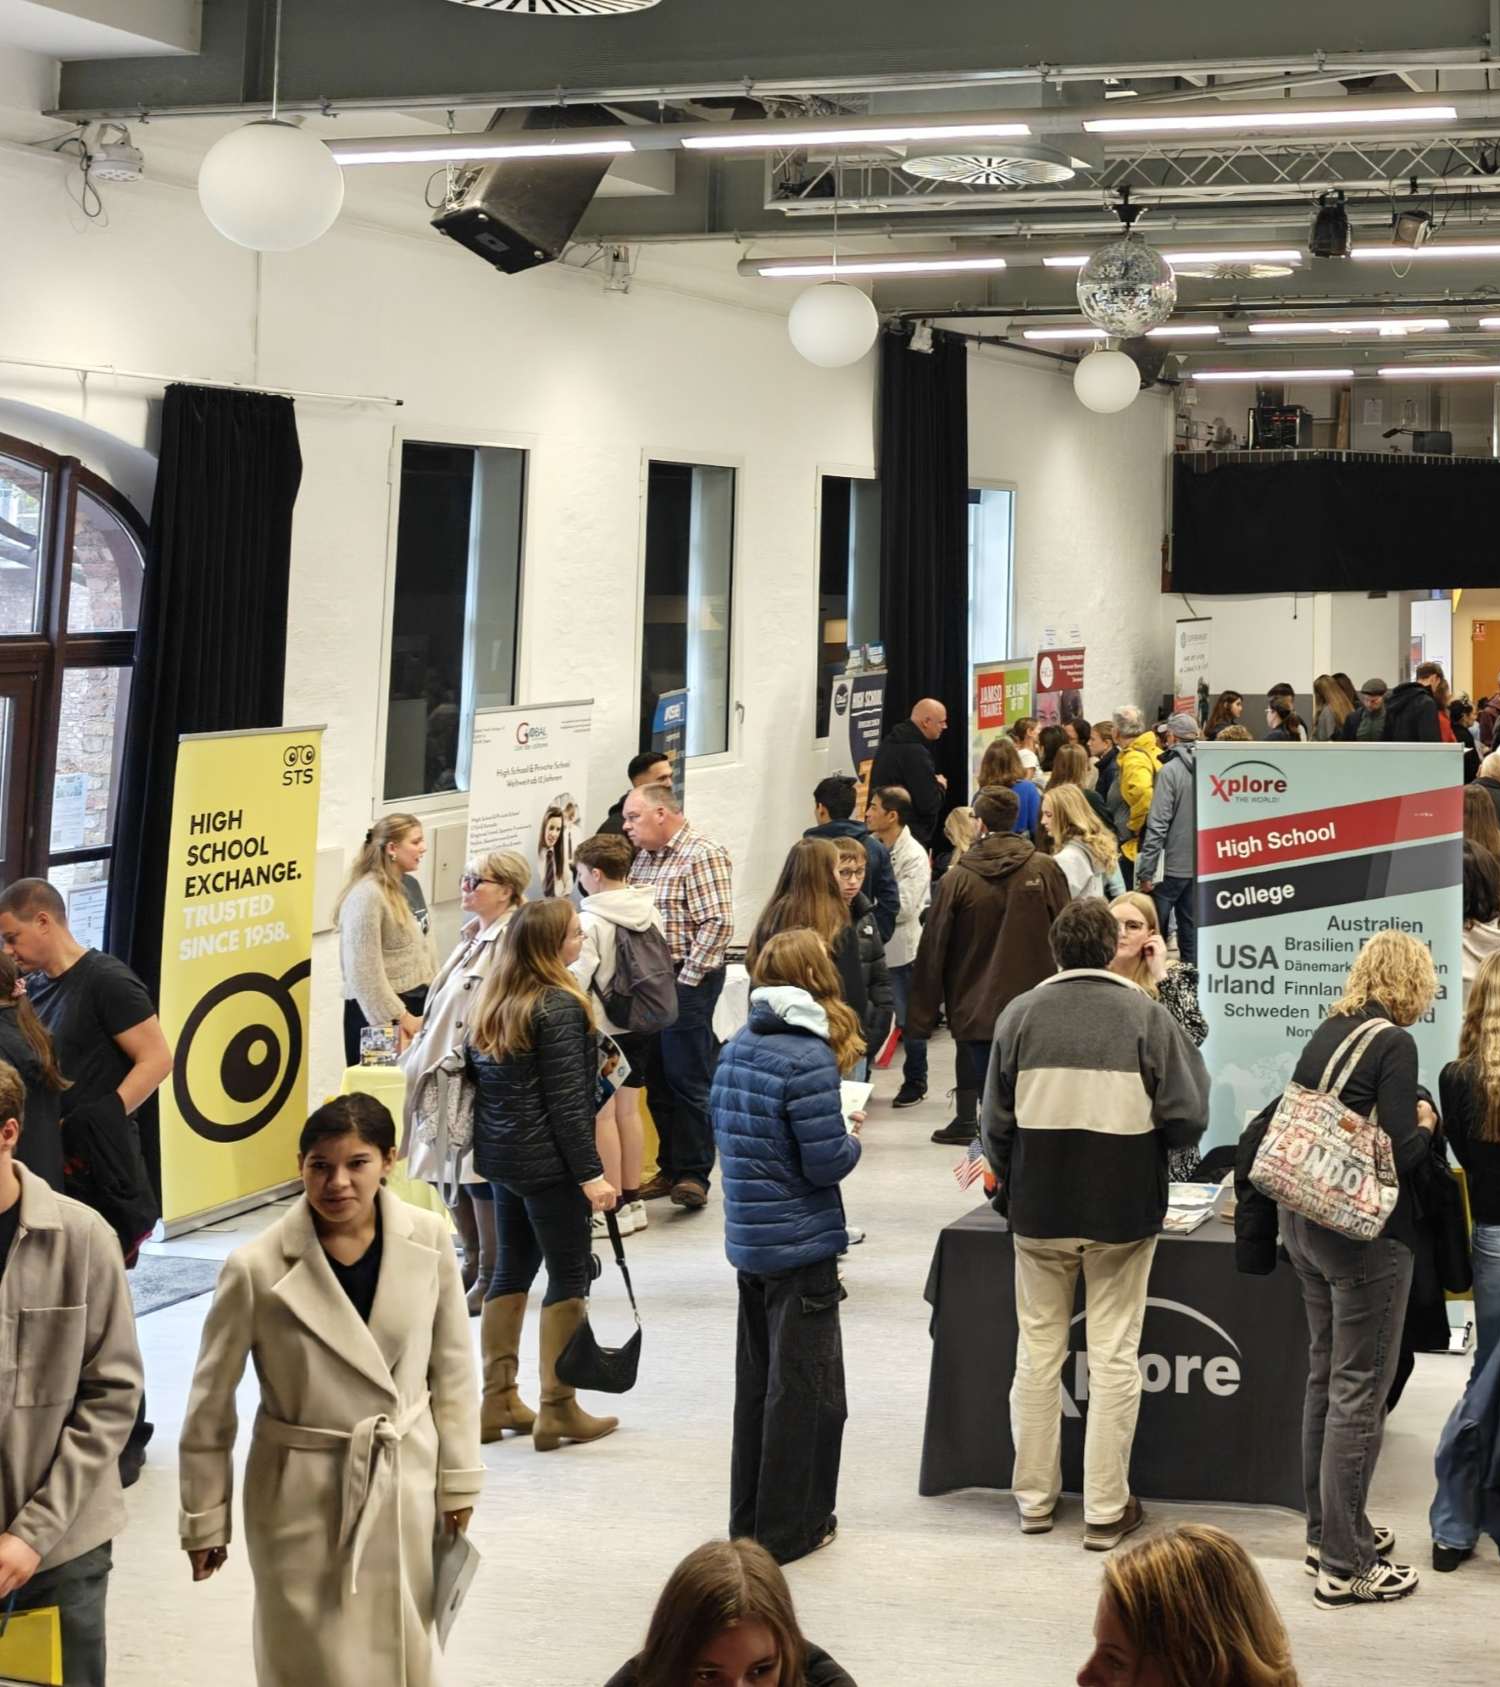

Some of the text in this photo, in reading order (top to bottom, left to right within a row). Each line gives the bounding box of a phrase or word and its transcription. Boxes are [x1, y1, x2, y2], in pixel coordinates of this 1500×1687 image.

[282, 768, 314, 786] STS
[1209, 775, 1287, 802] Xplore
[190, 809, 243, 835] HIGH
[186, 836, 269, 866] SCHOOL
[1216, 822, 1336, 859] High School
[185, 860, 302, 898] EXCHANGE.
[1216, 884, 1295, 909] College
[182, 894, 274, 929] TRUSTED
[1327, 915, 1424, 933] Australien
[179, 929, 241, 961] SINCE
[1216, 944, 1280, 970] USA
[1284, 937, 1354, 952] Brasilien
[1284, 960, 1351, 973] Dänemark
[1208, 973, 1275, 995] Irland
[1284, 981, 1343, 997] Finnlan
[1224, 1003, 1310, 1019] Schweden
